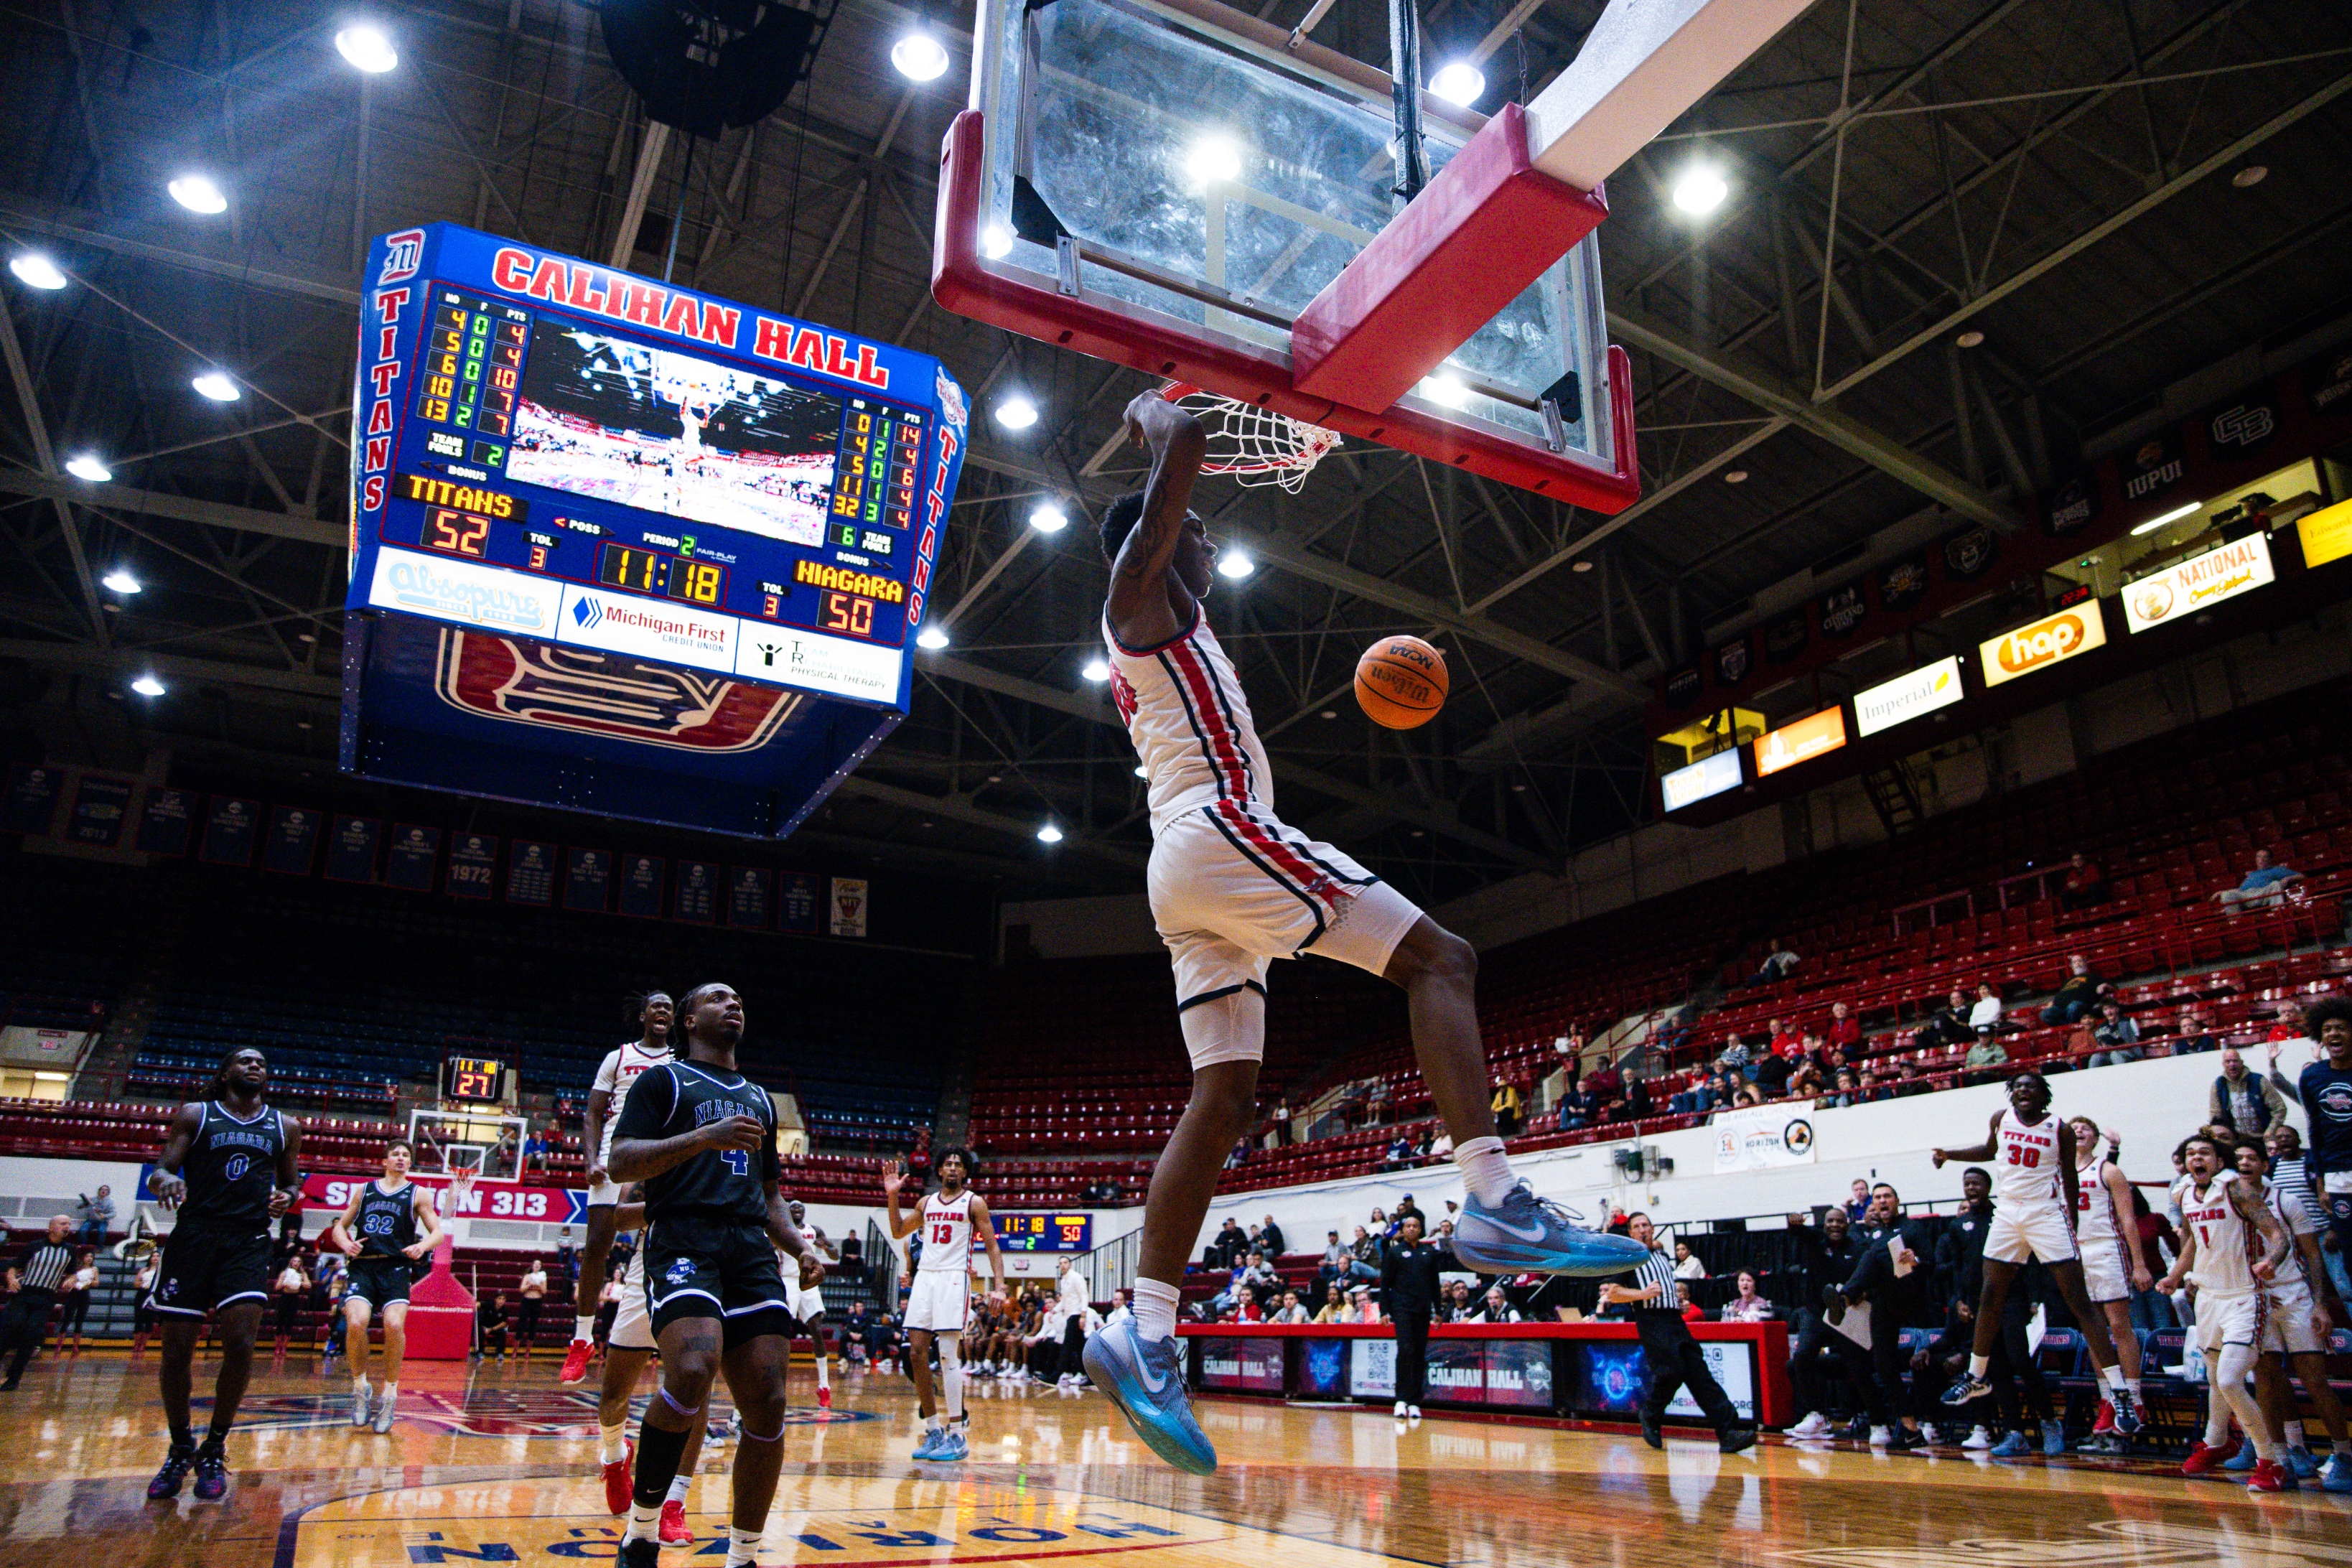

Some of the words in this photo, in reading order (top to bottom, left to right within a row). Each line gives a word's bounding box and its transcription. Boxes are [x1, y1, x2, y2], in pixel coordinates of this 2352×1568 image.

[445, 292, 460, 304] NO
[480, 302, 487, 312] F
[506, 309, 528, 322] PTS
[452, 310, 467, 331] 4
[474, 316, 490, 336] 0
[511, 325, 526, 346] 4
[491, 247, 741, 350] CALIHAN
[753, 315, 890, 391] HALL
[447, 332, 461, 353] 5
[470, 338, 485, 358] 0
[508, 348, 522, 369] 4
[442, 354, 457, 375] 6
[465, 360, 480, 382] 0
[495, 368, 517, 391] 10
[363, 286, 410, 511] TITANS
[431, 375, 453, 398] 10
[468, 384, 475, 404] 1
[500, 392, 514, 412] 7
[424, 400, 449, 421] 13
[455, 406, 472, 426] 2
[496, 414, 509, 435] 7
[853, 398, 866, 411] NO
[882, 406, 889, 416] F
[904, 412, 920, 424] PTS
[431, 432, 464, 448] TEAM
[858, 415, 870, 434] 0
[883, 421, 889, 437] 1
[902, 426, 920, 445] 14
[428, 440, 463, 457] FOULS
[487, 444, 503, 466] 2
[856, 438, 867, 456] 4
[874, 439, 886, 458] 2
[906, 449, 917, 466] 4
[447, 465, 487, 482] BONUS
[852, 456, 864, 475] 5
[871, 460, 885, 480] 0
[902, 469, 914, 487] 6
[2126, 459, 2183, 500] IUPUI
[410, 474, 513, 518] TITANS
[844, 475, 862, 494] 11
[874, 484, 881, 500] 1
[900, 490, 912, 508] 4
[833, 496, 859, 518] 32
[865, 503, 878, 523] 3
[898, 509, 910, 529] 4
[433, 508, 489, 555] 52
[569, 518, 601, 536] POSS
[841, 526, 855, 546] 6
[907, 424, 958, 626] TITANS
[530, 531, 554, 546] TOL
[643, 532, 679, 548] PERIOD
[681, 536, 695, 557] 2
[862, 539, 891, 554] FOULS
[864, 531, 891, 546] TEAM
[531, 547, 546, 569] 3
[836, 551, 870, 568] BONUS
[2178, 542, 2257, 588] NATIONAL
[618, 548, 720, 604] 11:18
[795, 559, 904, 605] NIAGARA
[762, 582, 784, 596] TOL
[765, 595, 778, 616] 3
[828, 593, 874, 635] 50
[606, 607, 684, 638] Michigan
[688, 622, 725, 643] First
[663, 634, 695, 648] CREDIT
[697, 641, 724, 653] UNION
[2008, 623, 2075, 666] hap
[1389, 645, 1434, 671] NCAA
[791, 666, 839, 681] PHYSICAL
[843, 673, 887, 689] THERAPY
[1371, 666, 1429, 703] Wilson
[1865, 681, 1933, 719] Imperial
[452, 864, 491, 885] 1972
[624, 1065, 650, 1076] TIT
[458, 1073, 489, 1096] 27
[695, 1099, 762, 1128] NIAGAR
[210, 1131, 273, 1157] NIAGARA
[1745, 1137, 1780, 1149] HORIZON
[2003, 1131, 2050, 1147] TITANS
[225, 1152, 251, 1182] 0
[720, 1149, 749, 1176] 4
[2007, 1145, 2040, 1168] 30
[364, 1201, 401, 1218] NIAGARA
[491, 1191, 548, 1217] 313
[364, 1213, 394, 1235] 32
[925, 1212, 964, 1222] TITANS
[1005, 1217, 1045, 1233] 11:18
[933, 1224, 952, 1243] 13
[1026, 1236, 1035, 1250] 2
[1063, 1226, 1081, 1242] 50
[2199, 1226, 2210, 1249] 1
[1203, 1359, 1240, 1376] CALIHAN
[1241, 1361, 1266, 1377] HALL
[1427, 1367, 1483, 1388] CALIHAN
[1486, 1369, 1523, 1390] HALL
